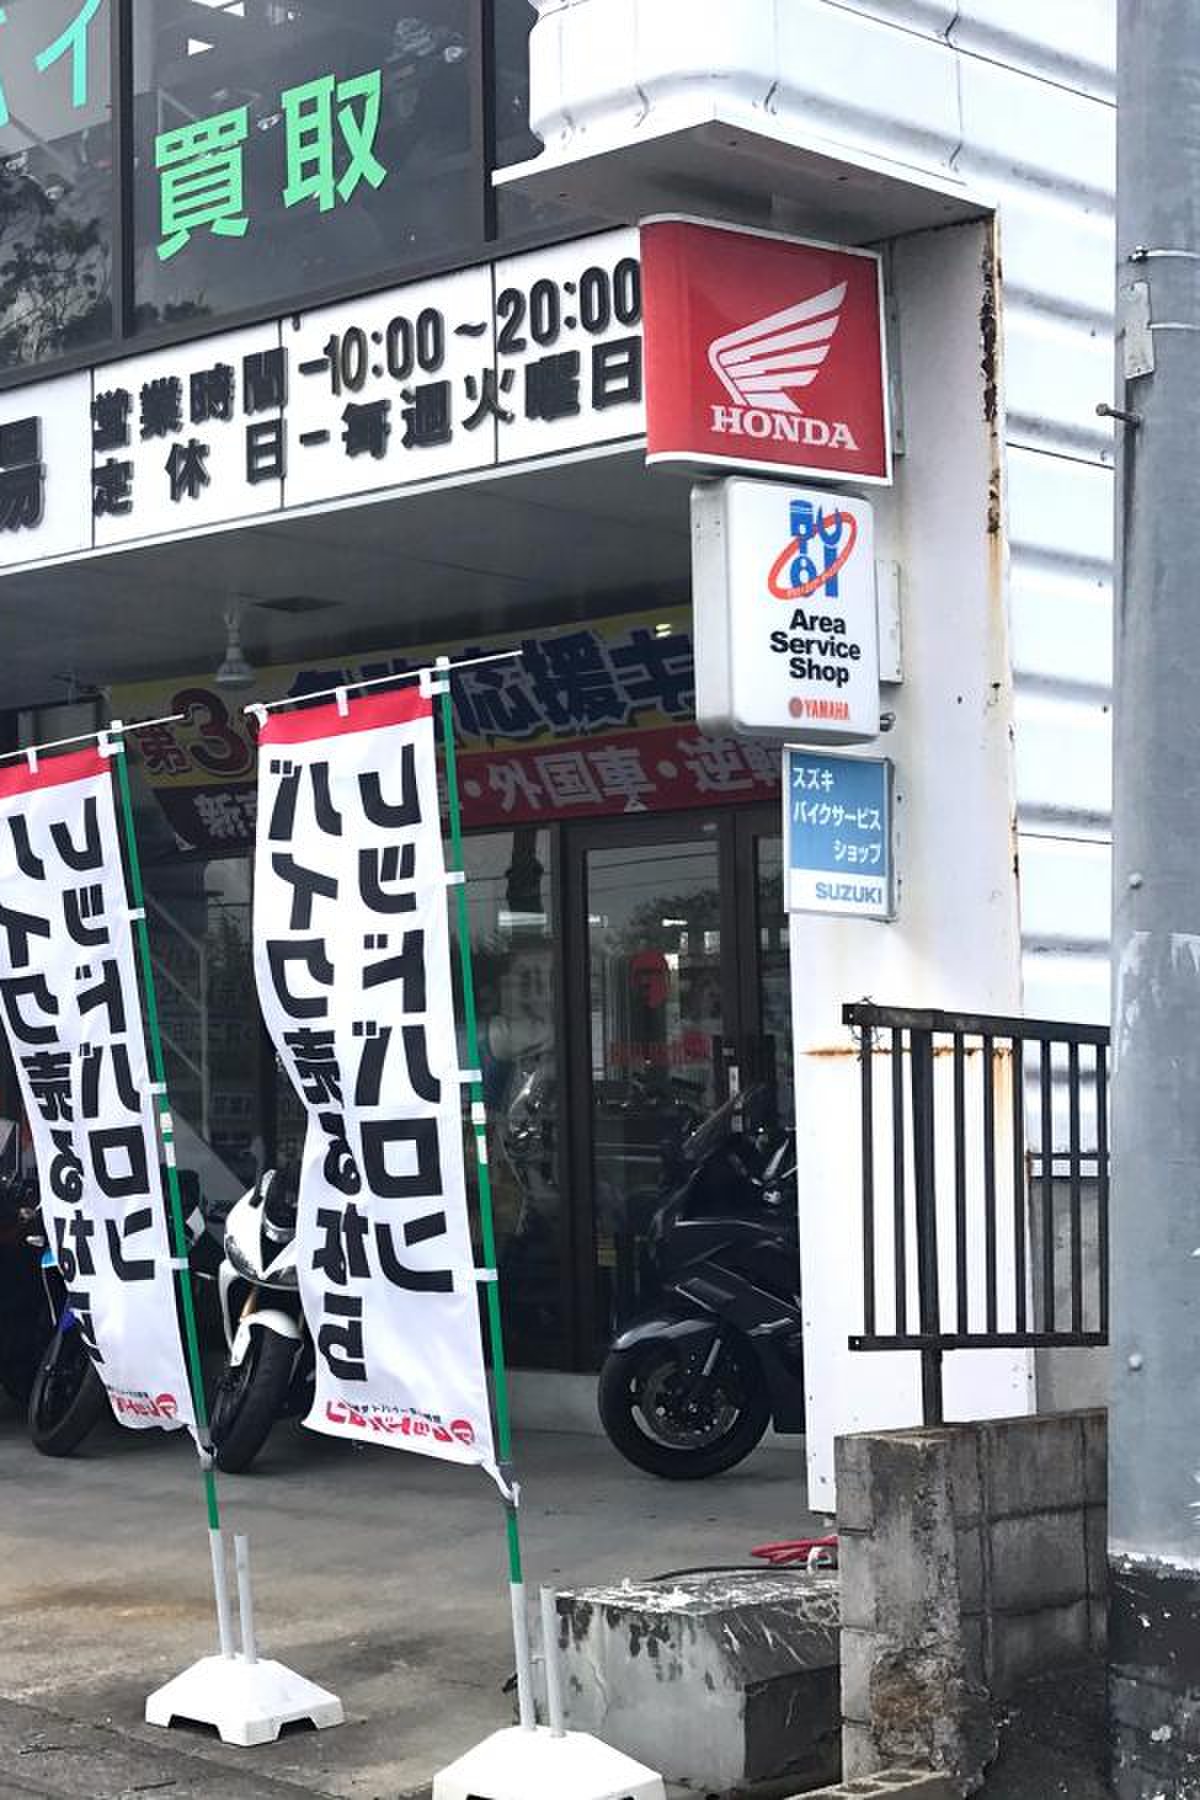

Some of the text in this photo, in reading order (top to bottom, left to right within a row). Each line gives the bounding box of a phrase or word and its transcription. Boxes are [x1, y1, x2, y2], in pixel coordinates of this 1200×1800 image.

[155, 69, 388, 262] 買取
[710, 404, 860, 452] HONDA
[789, 608, 846, 635] Area
[769, 631, 862, 660] Service
[788, 656, 849, 688] Shop
[803, 699, 851, 721] YAMAHA
[792, 767, 835, 793] スズキ
[792, 800, 881, 832] バイクサービス
[833, 838, 882, 866] ショップ
[814, 881, 883, 905] SUZUKI
